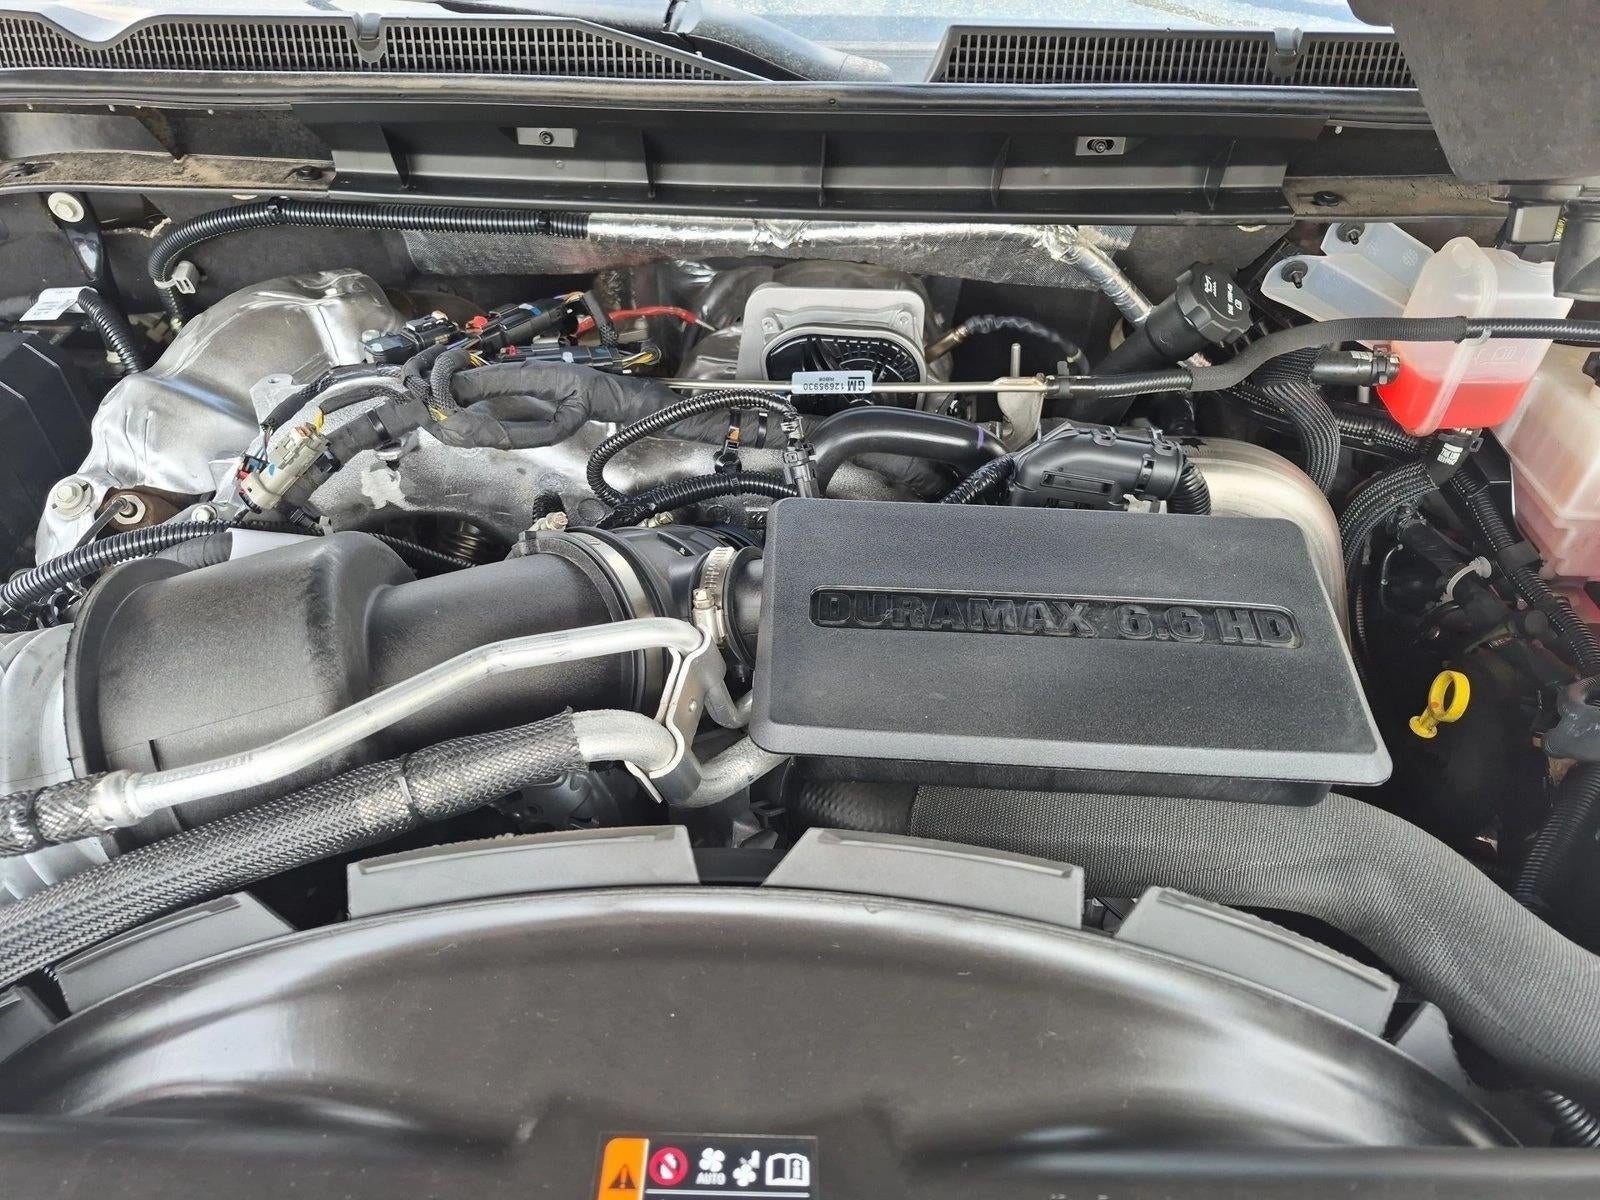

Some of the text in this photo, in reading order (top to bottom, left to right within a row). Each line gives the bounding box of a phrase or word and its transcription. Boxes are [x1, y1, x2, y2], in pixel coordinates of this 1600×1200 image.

[803, 380, 865, 392] GM 12695930
[818, 590, 1299, 646] DURAMAX 6.6 HD
[695, 1172, 726, 1185] AUTO
